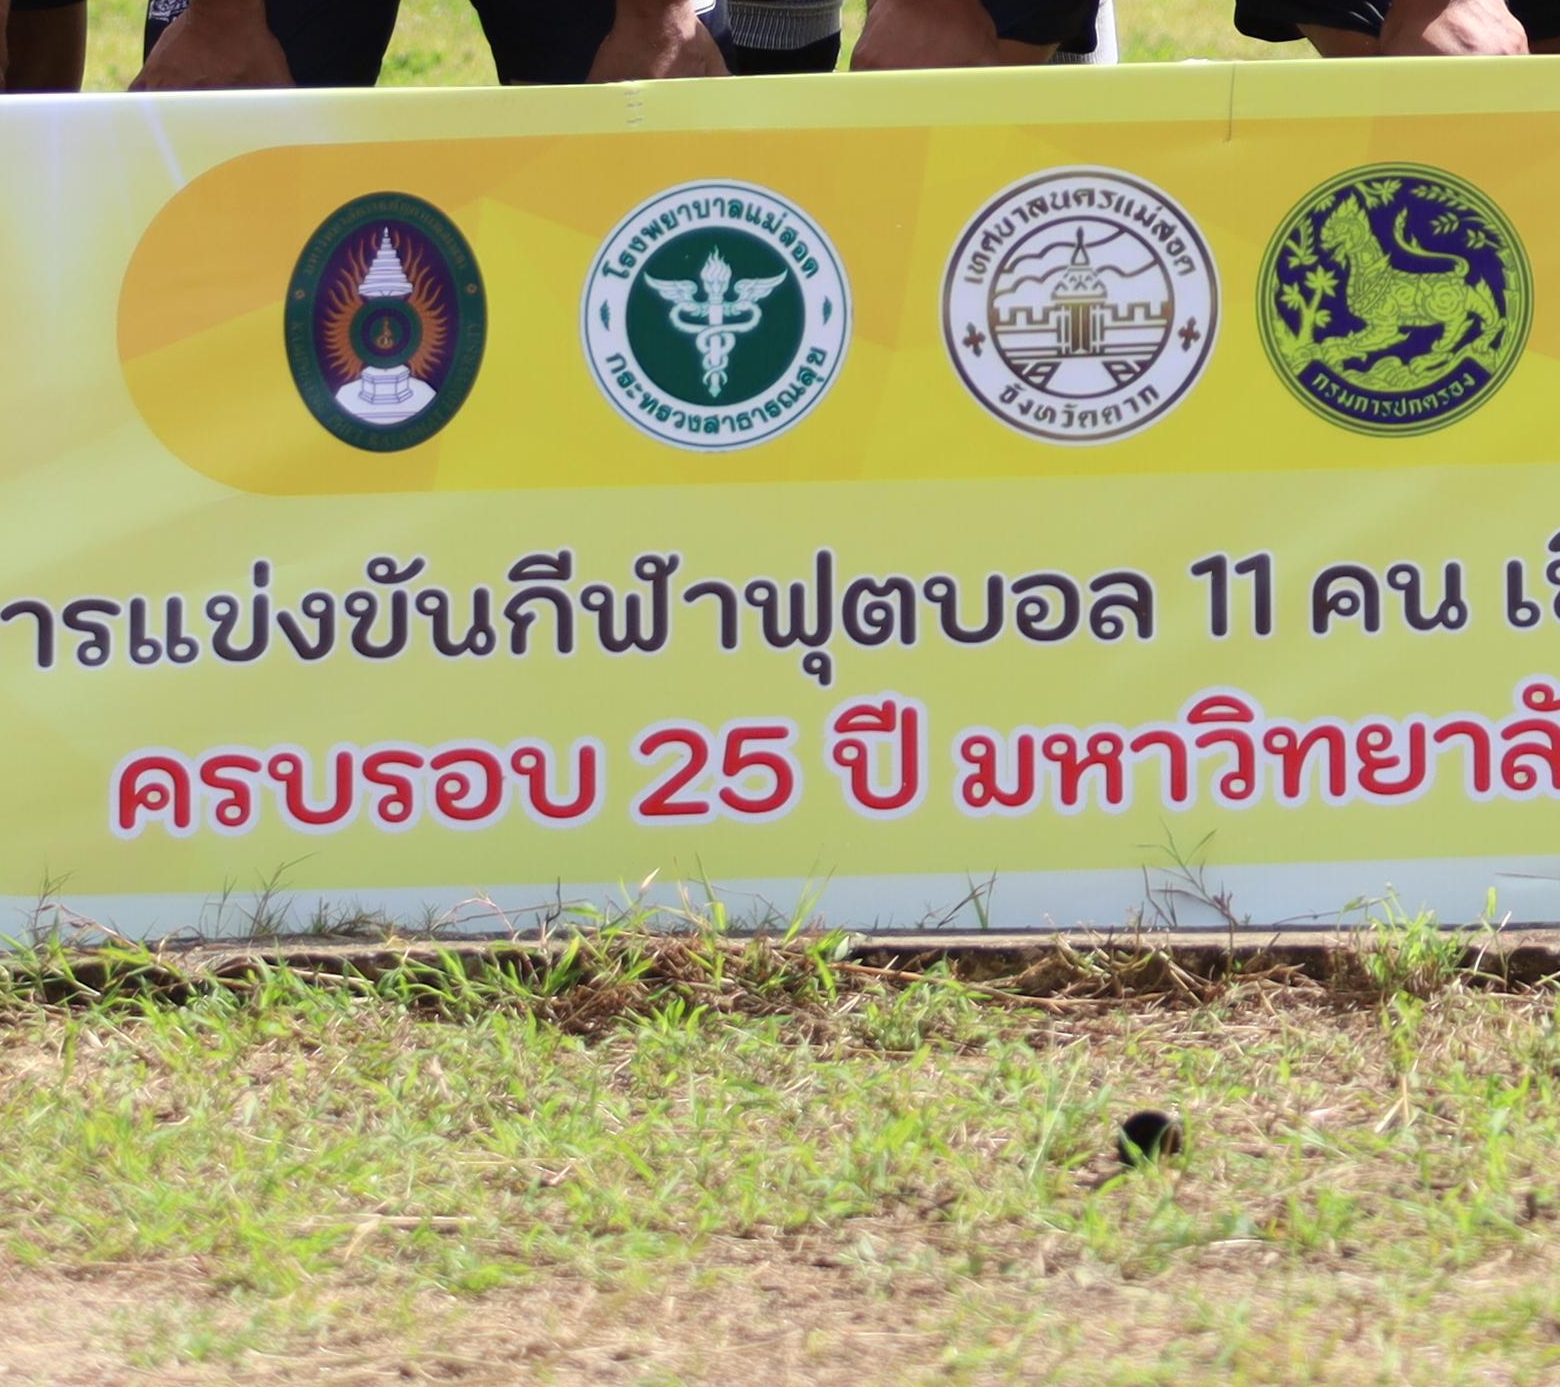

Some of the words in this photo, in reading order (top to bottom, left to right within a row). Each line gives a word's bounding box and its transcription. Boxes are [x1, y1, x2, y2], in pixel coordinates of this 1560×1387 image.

[602, 197, 820, 279] โรงพยาบาลแม่สอด
[964, 188, 1197, 284] เทศบาลนครแม่สอด
[607, 347, 828, 434] กระทรวงสาธารณสุข
[999, 383, 1160, 428] จังหวัดตาก
[1312, 373, 1476, 417] กรมการปกครอง
[1191, 551, 1272, 638] 11
[1311, 561, 1468, 635] คน
[119, 744, 596, 830] ครบรอบ
[638, 726, 795, 818] 25
[834, 699, 918, 811] ปี
